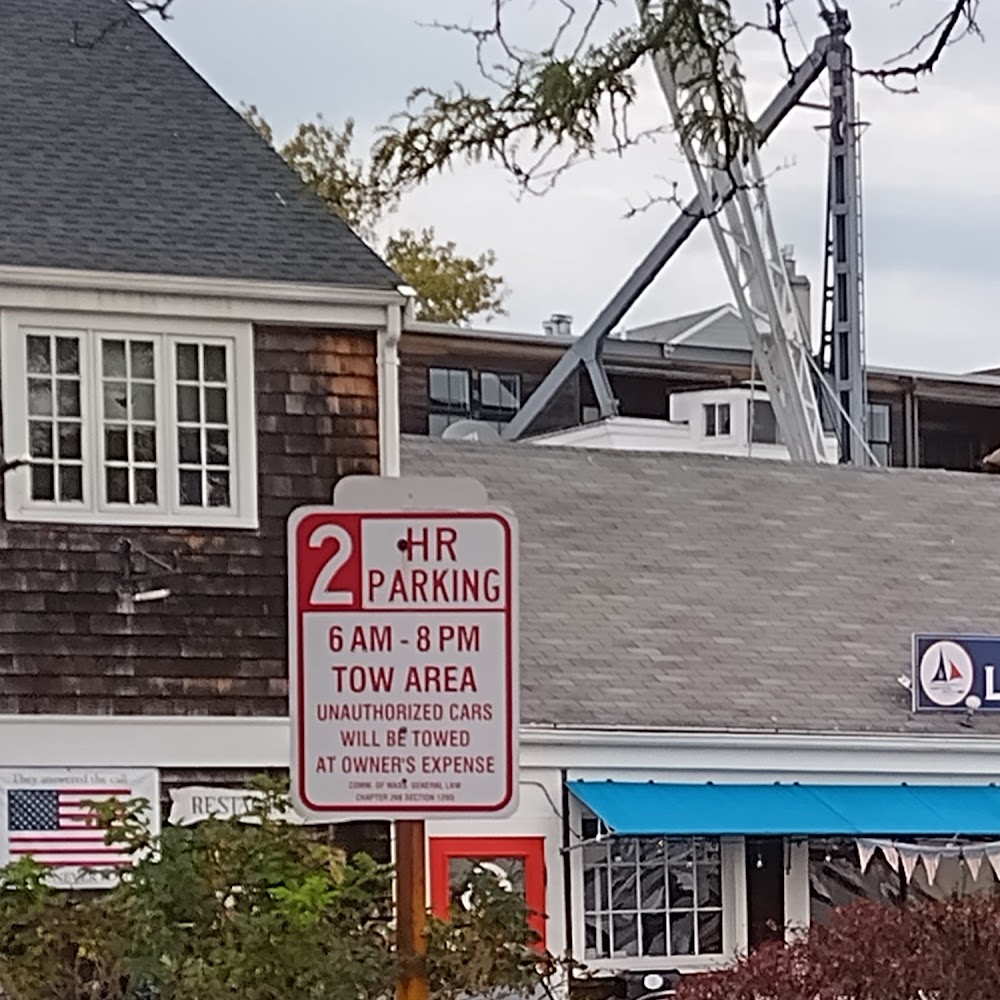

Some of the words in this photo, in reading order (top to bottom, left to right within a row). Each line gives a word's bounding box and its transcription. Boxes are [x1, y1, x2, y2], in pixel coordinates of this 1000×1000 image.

[405, 527, 458, 562] HR
[308, 523, 354, 605] 2
[368, 568, 501, 603] PARKING
[328, 625, 344, 652] 6
[350, 625, 392, 652] AM
[416, 625, 431, 652] 8
[438, 625, 480, 652] PM
[332, 666, 395, 693] TOW
[405, 666, 478, 693] AREA
[316, 703, 443, 721] UNAUTHORIZED
[449, 703, 493, 721] CARS
[340, 730, 381, 747] WILL
[386, 730, 407, 747] BE
[413, 730, 470, 747] TOWED
[316, 757, 337, 774] AT
[341, 757, 416, 774] OWNER'S
[422, 757, 496, 774] EXPENSE
